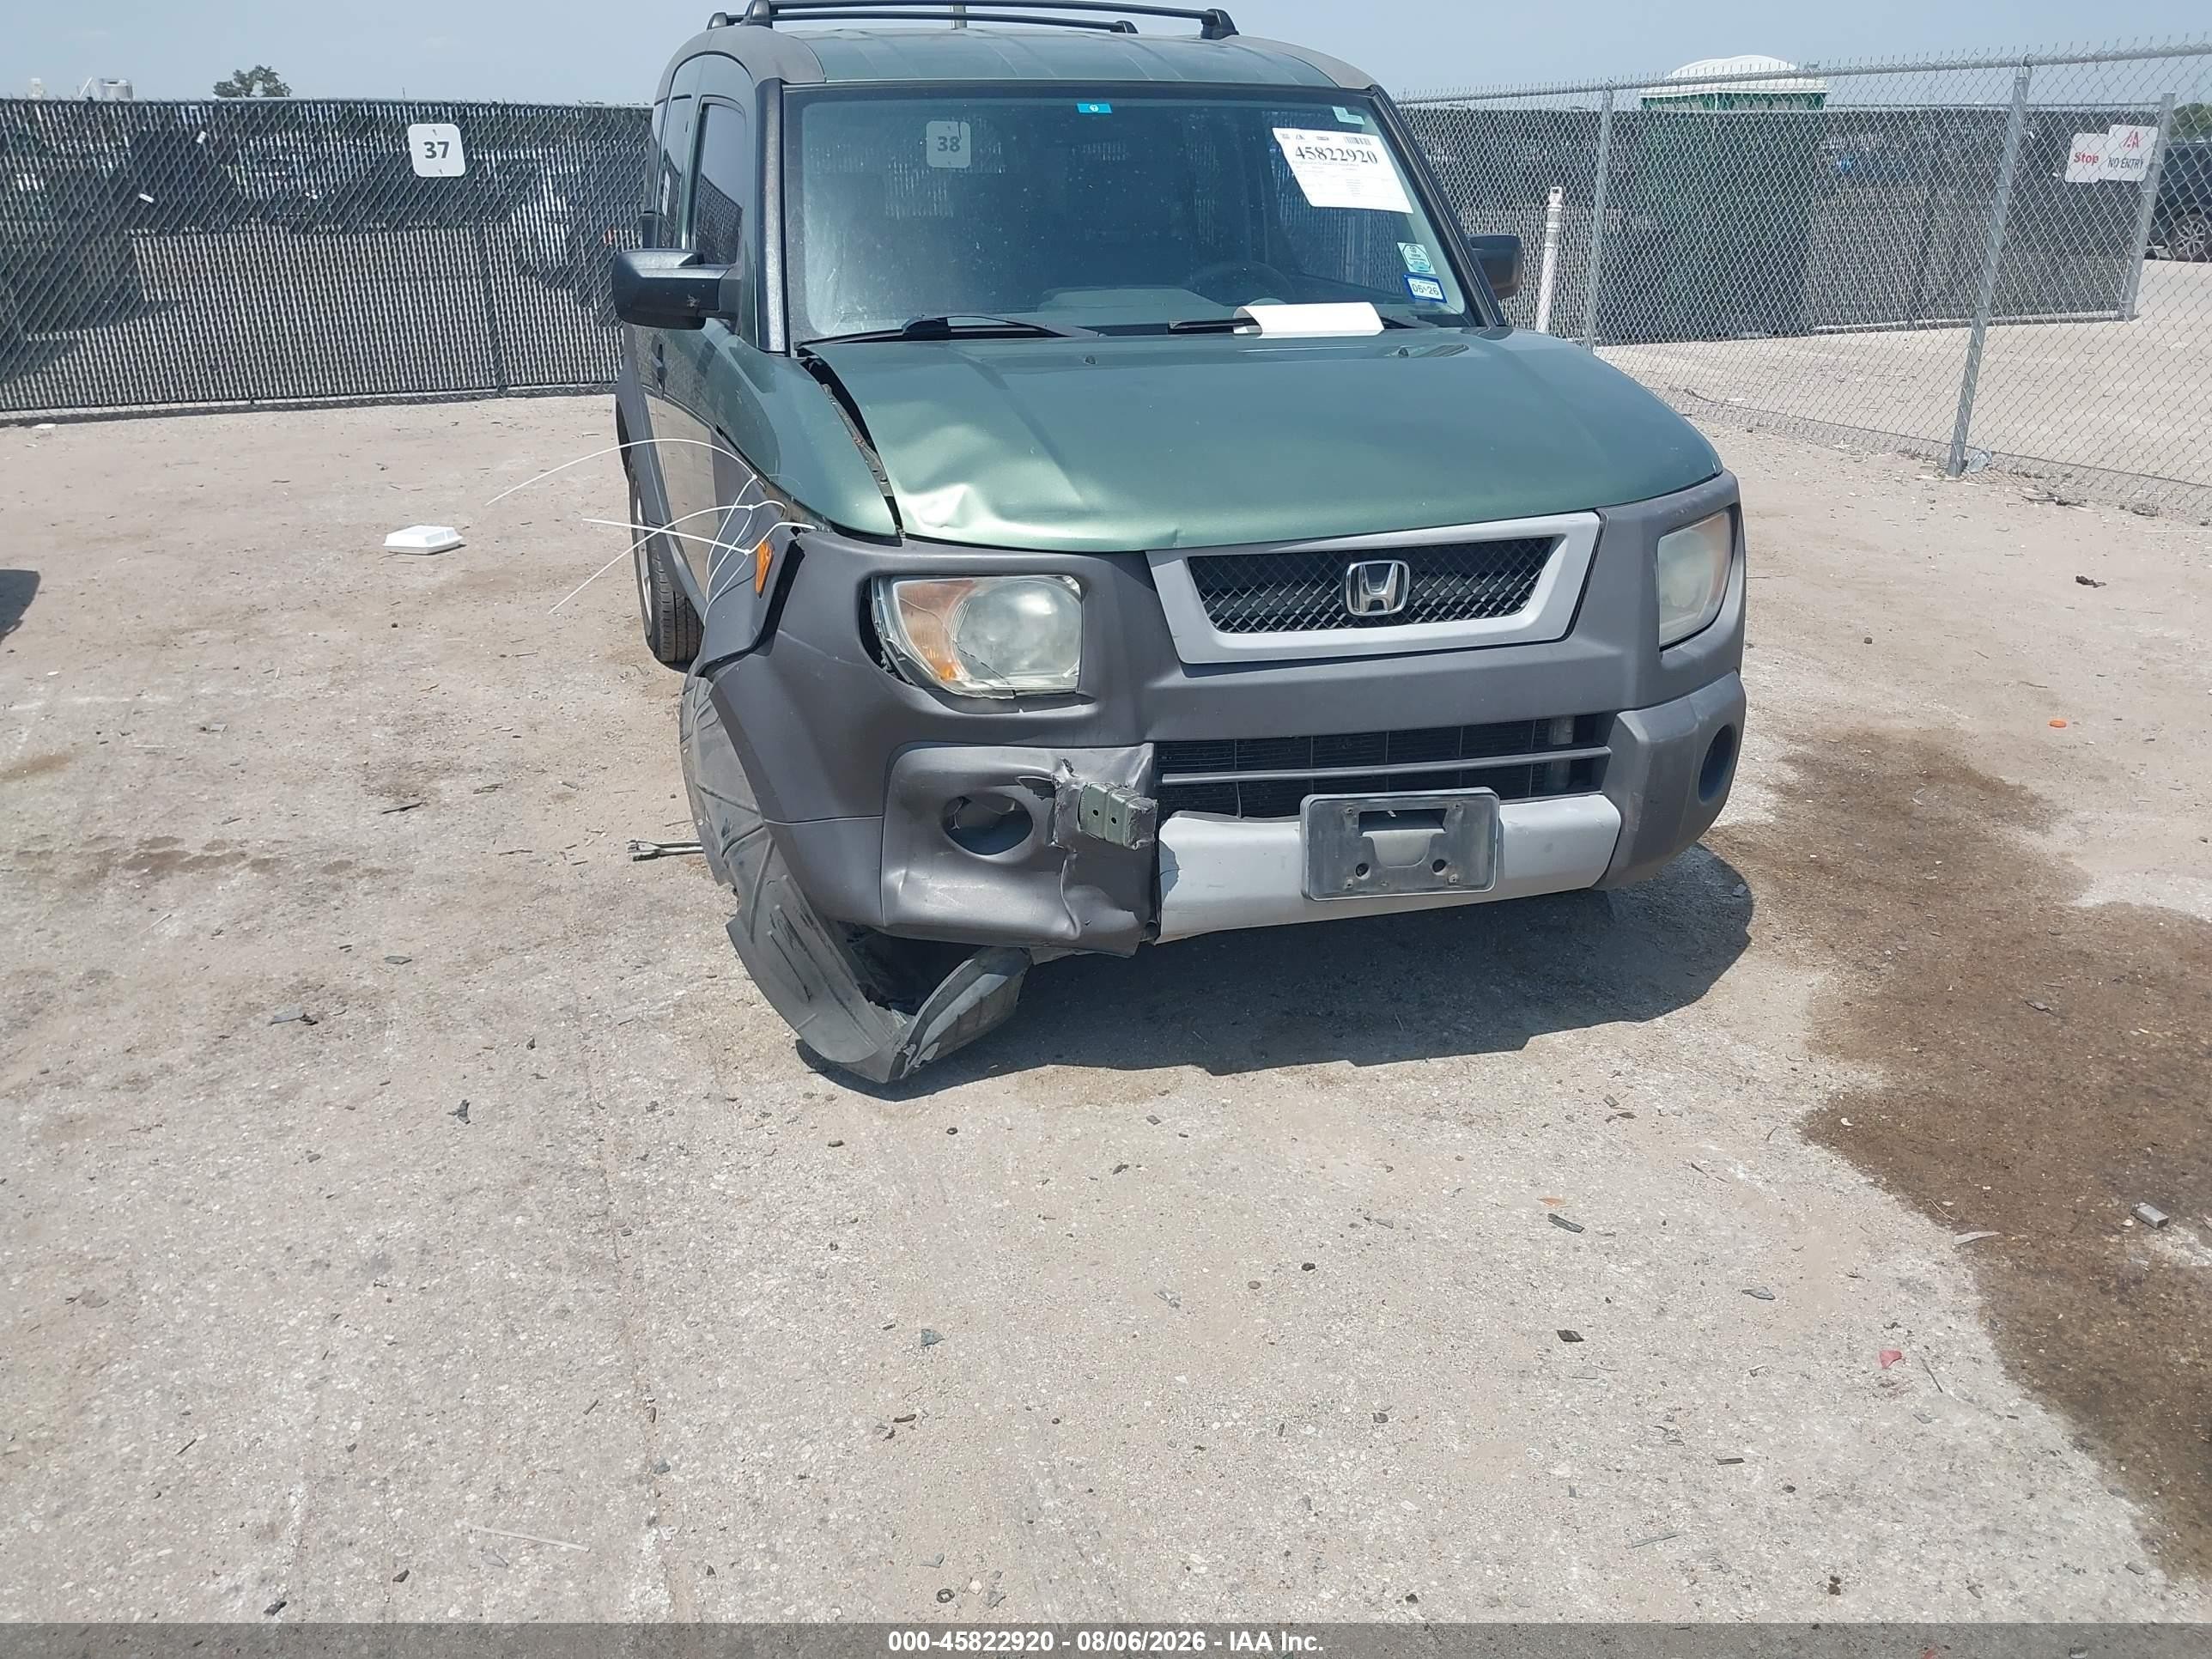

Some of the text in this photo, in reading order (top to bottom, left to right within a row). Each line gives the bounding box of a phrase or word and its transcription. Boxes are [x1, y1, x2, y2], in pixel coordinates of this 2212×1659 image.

[423, 141, 450, 159] 37
[937, 136, 961, 153] 38
[1295, 146, 1378, 164] 45822920
[2074, 152, 2099, 166] Stop
[2107, 157, 2143, 170] NO ENTRY
